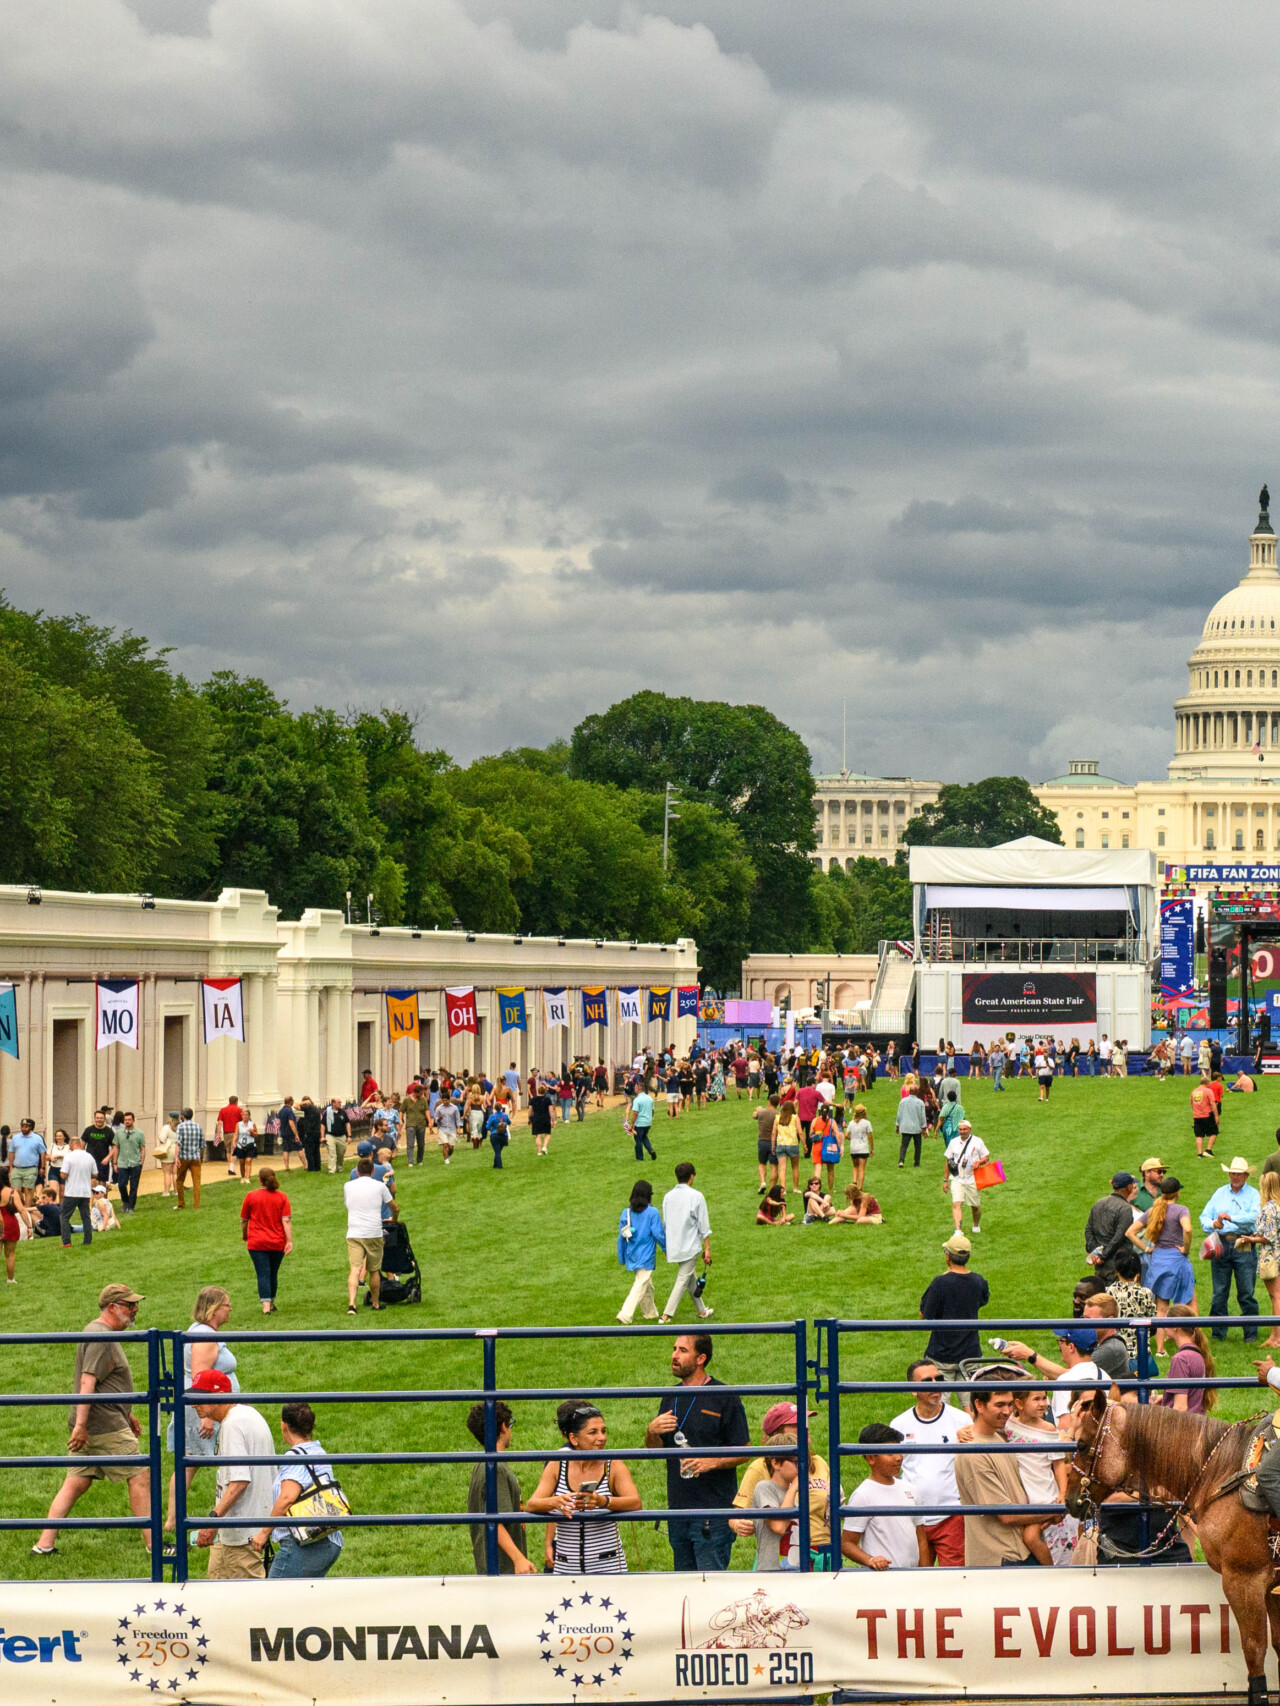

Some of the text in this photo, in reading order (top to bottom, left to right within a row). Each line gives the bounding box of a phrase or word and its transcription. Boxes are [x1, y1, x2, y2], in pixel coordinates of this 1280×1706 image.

[1190, 868, 1218, 879] FIFA
[1222, 868, 1248, 879] FAN
[621, 1002, 639, 1017] MA
[652, 1002, 667, 1016] NY
[680, 998, 697, 1009] 250
[975, 996, 1085, 1006] Great American State Fair
[213, 1003, 235, 1028] IA
[450, 1007, 474, 1026] OH
[505, 1007, 522, 1024] DE
[550, 1004, 565, 1020] RI
[586, 1003, 604, 1019] NH
[0, 1015, 11, 1041] N
[102, 1009, 134, 1035] MO
[393, 1012, 414, 1031] NJ
[132, 1629, 188, 1640] Freedom
[558, 1623, 614, 1635] Freedom
[856, 1607, 964, 1660] THE
[249, 1624, 499, 1662] MONTANA
[559, 1635, 614, 1663] 250
[136, 1640, 190, 1667] 250
[675, 1651, 814, 1687] RODEO 250
